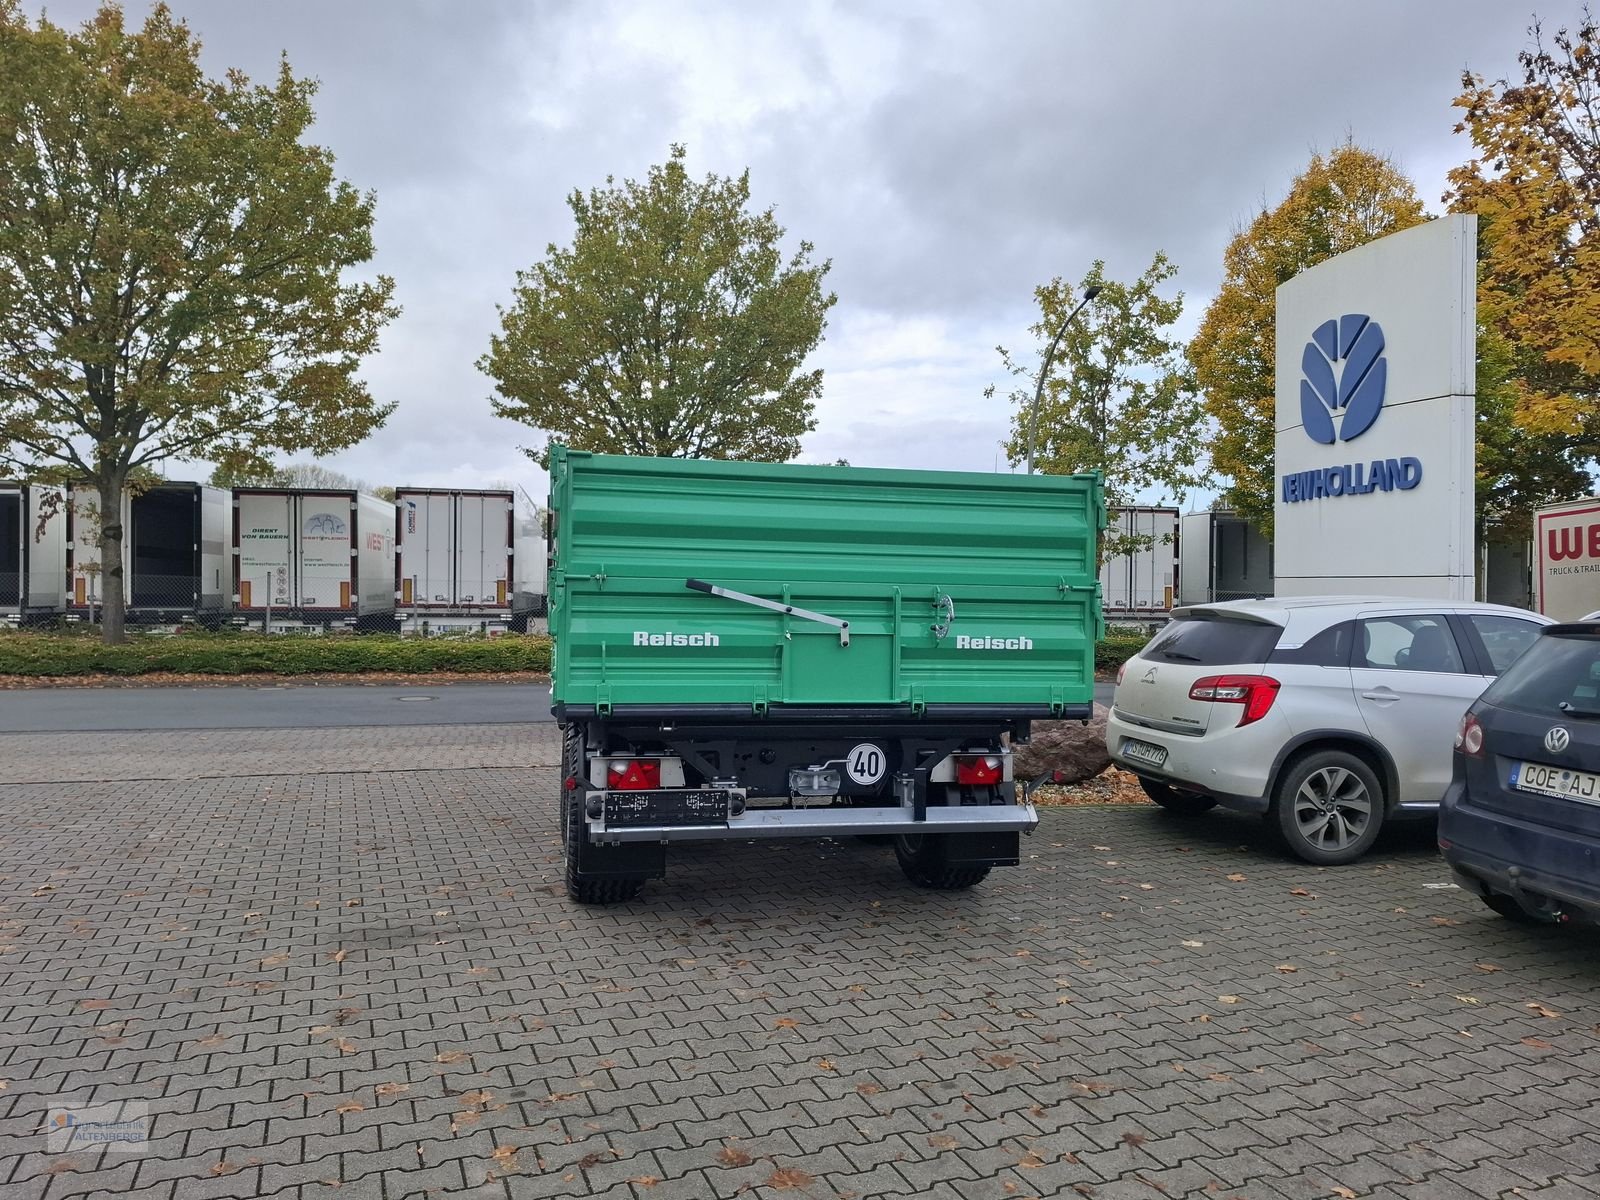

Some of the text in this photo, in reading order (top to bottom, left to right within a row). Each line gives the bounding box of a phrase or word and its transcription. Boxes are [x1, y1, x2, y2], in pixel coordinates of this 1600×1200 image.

[366, 532, 385, 552] WEST
[1549, 566, 1573, 576] TRUCK
[1573, 566, 1580, 574] &
[633, 631, 720, 647] Reisch
[956, 635, 1034, 650] Reisch
[852, 751, 879, 778] 40
[1525, 766, 1559, 789] COE
[1569, 774, 1597, 796] AJ
